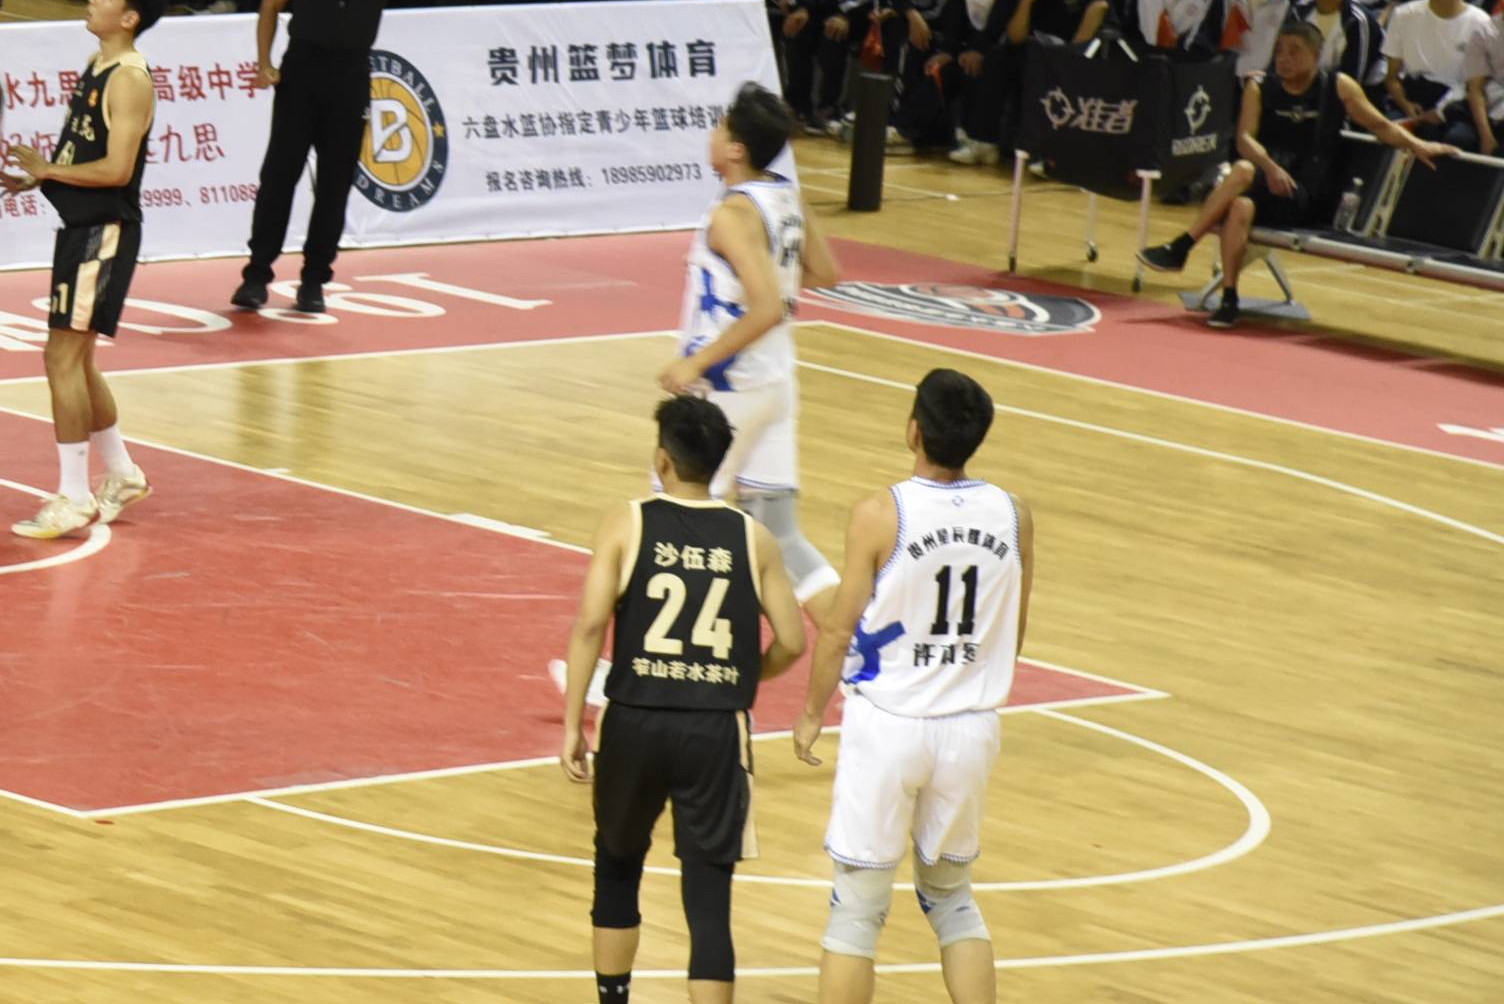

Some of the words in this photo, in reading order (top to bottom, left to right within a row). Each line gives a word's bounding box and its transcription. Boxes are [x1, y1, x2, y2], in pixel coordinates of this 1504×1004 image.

[487, 39, 717, 85] 贵州篮梦体育
[643, 572, 734, 659] 24
[930, 565, 978, 636] 11
